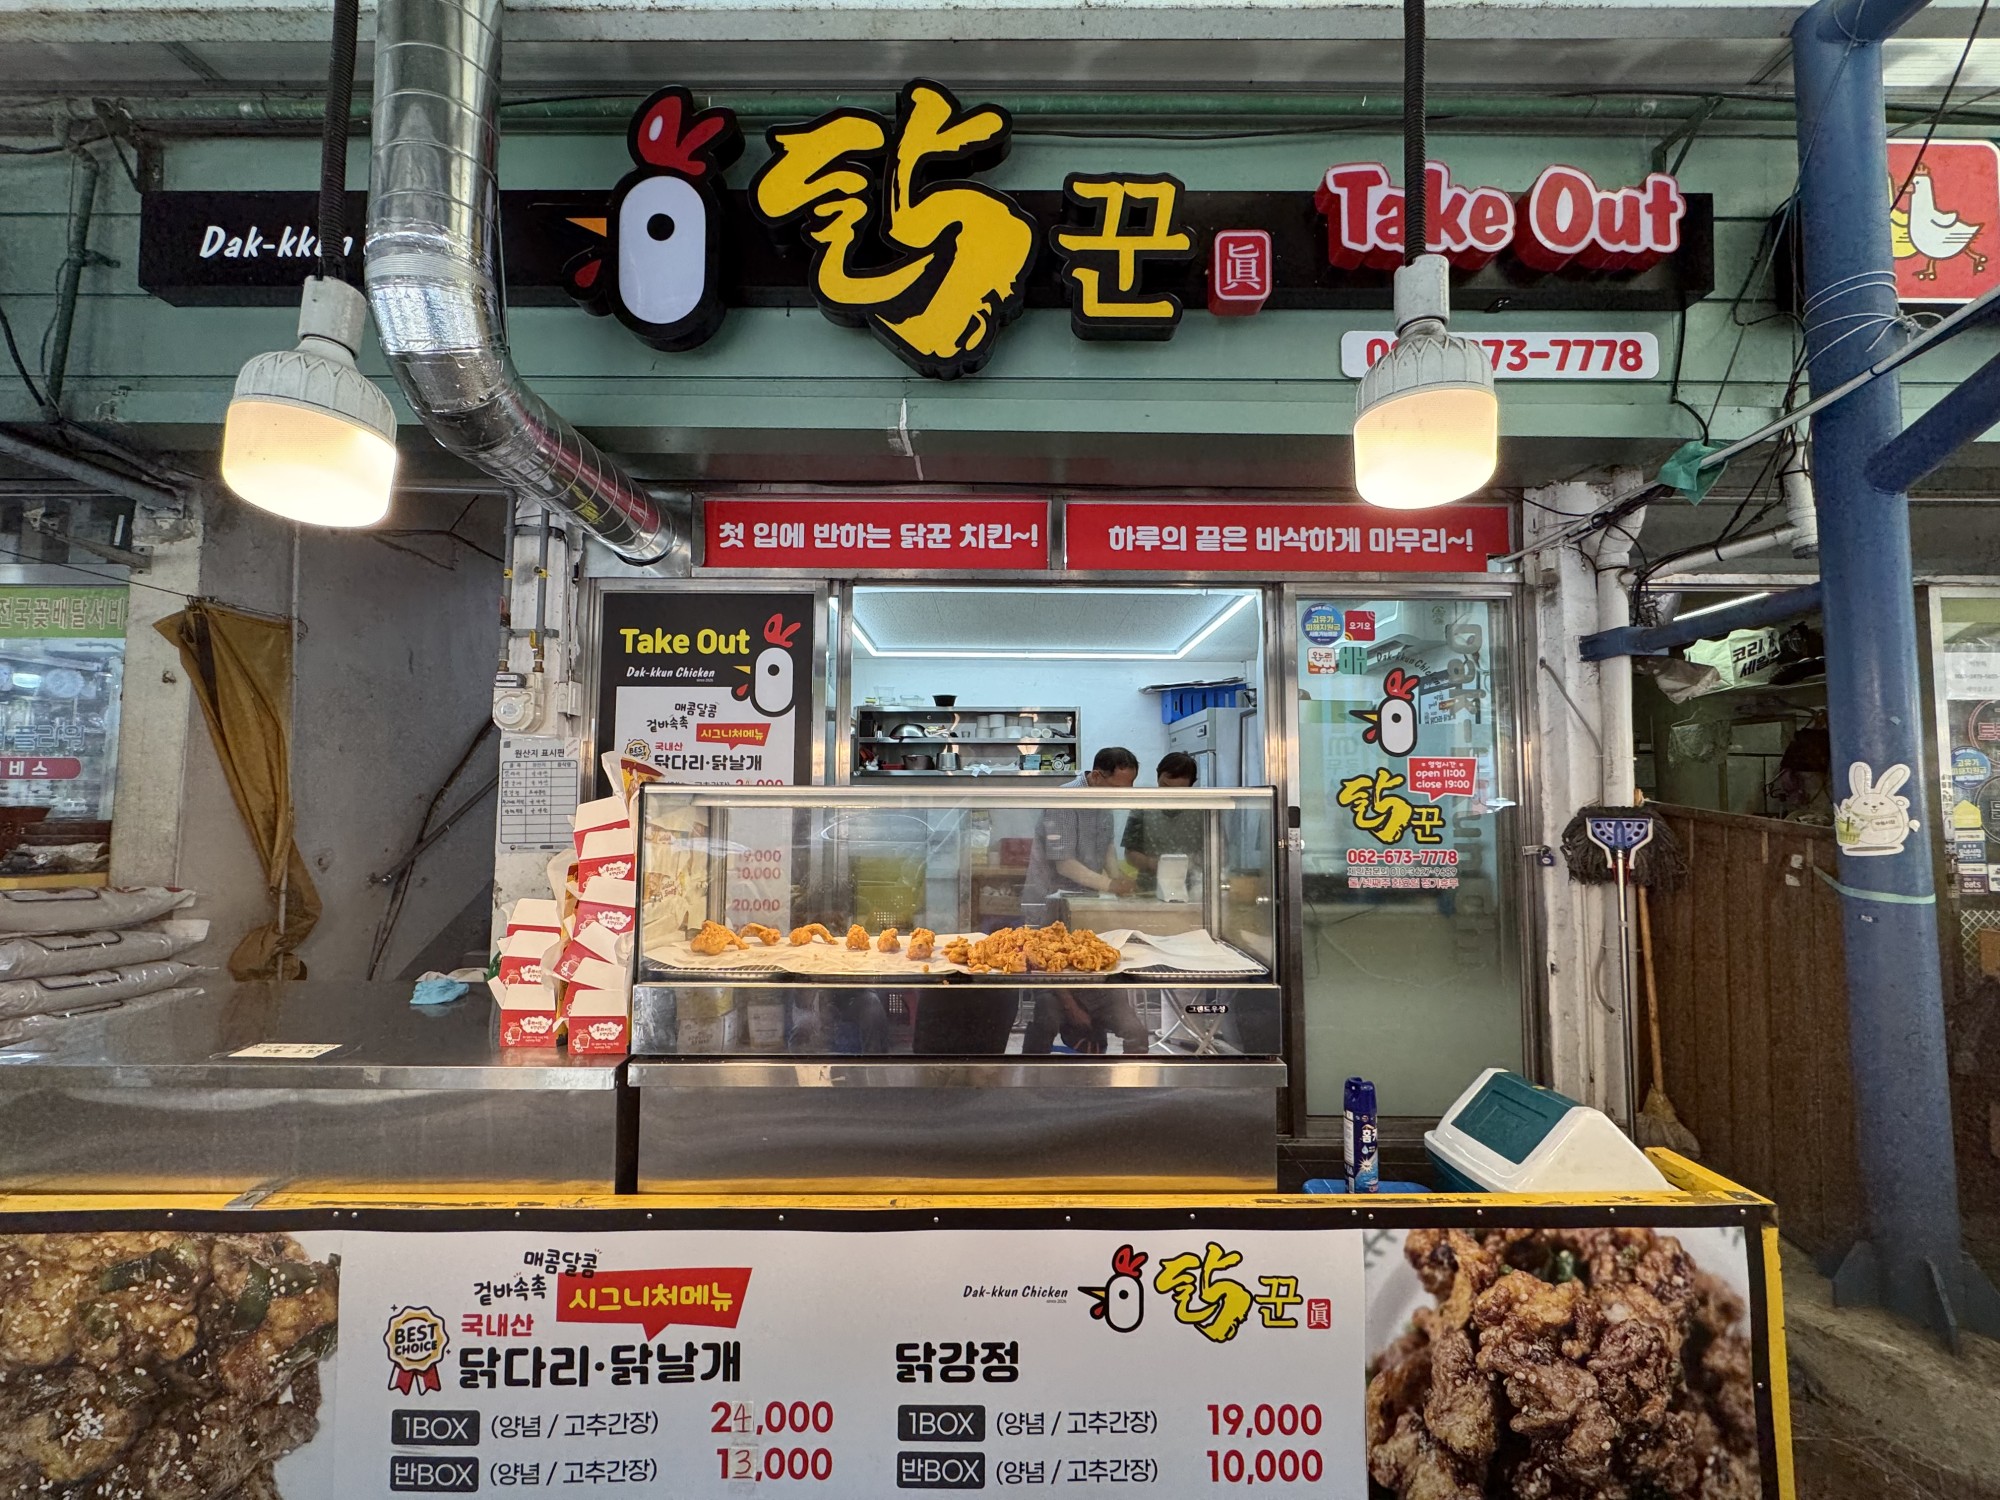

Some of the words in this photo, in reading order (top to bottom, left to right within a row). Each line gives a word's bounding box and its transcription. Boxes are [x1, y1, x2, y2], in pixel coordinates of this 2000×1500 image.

[1329, 164, 1514, 251] Take
[1531, 166, 1684, 253] Out
[719, 523, 744, 548] 첫
[753, 523, 805, 548] 입에
[813, 523, 892, 549] 반하는
[900, 523, 952, 549] 닭꾼
[960, 523, 1038, 549] 치킨~!
[1108, 526, 1187, 551] 하루의
[1195, 526, 1248, 552] 끝은
[1256, 527, 1361, 552] 바삭하게
[1369, 528, 1473, 553] 마무리~!
[0, 597, 129, 630] 전국꽃배달서비
[1348, 622, 1372, 630] 요기요
[619, 628, 690, 654] Take
[696, 628, 750, 655] Out
[626, 666, 673, 678] Dak-kkun
[675, 666, 715, 678] Chicken
[674, 702, 718, 718] 매콤달콤
[646, 716, 689, 733] 겉바속촉
[700, 728, 764, 740] 시그니처메뉴
[654, 742, 683, 751] 국내산
[1416, 770, 1440, 778] open
[1443, 769, 1466, 778] 11:00
[1416, 780, 1442, 788] close
[1445, 780, 1470, 789] 19:00
[1347, 849, 1459, 865] 062-673-7778
[524, 1249, 598, 1279] 매콤달콤
[473, 1274, 547, 1306] 겉바속촉
[568, 1283, 734, 1313] 시그니처메뉴
[962, 1285, 1019, 1299] Dak-kkun
[1021, 1285, 1069, 1299] Chicken
[1155, 1241, 1303, 1343] 닭꾼
[394, 1324, 437, 1345] BEST
[461, 1313, 534, 1338] 국내산
[394, 1340, 438, 1357] CHOICE
[458, 1341, 742, 1389] 닭다리·닭날개
[896, 1341, 1020, 1384] 닭강정
[402, 1417, 469, 1440] 1BOX
[490, 1415, 542, 1439] (양념
[563, 1410, 659, 1438] 고추간장)
[710, 1400, 834, 1436] 24,000
[908, 1412, 974, 1435] 1BOX
[995, 1411, 1045, 1436] (양념
[1067, 1410, 1159, 1435] 고추간장)
[1207, 1403, 1323, 1439] 19,000
[394, 1462, 474, 1488] 반BOX
[489, 1461, 542, 1487] (양념
[563, 1457, 659, 1485] 고추간장)
[715, 1447, 833, 1483] 13,000
[902, 1457, 980, 1483] 반BOX
[995, 1458, 1046, 1484] (양념
[1067, 1457, 1159, 1484] 고추간장)
[1207, 1449, 1324, 1485] 10,000
